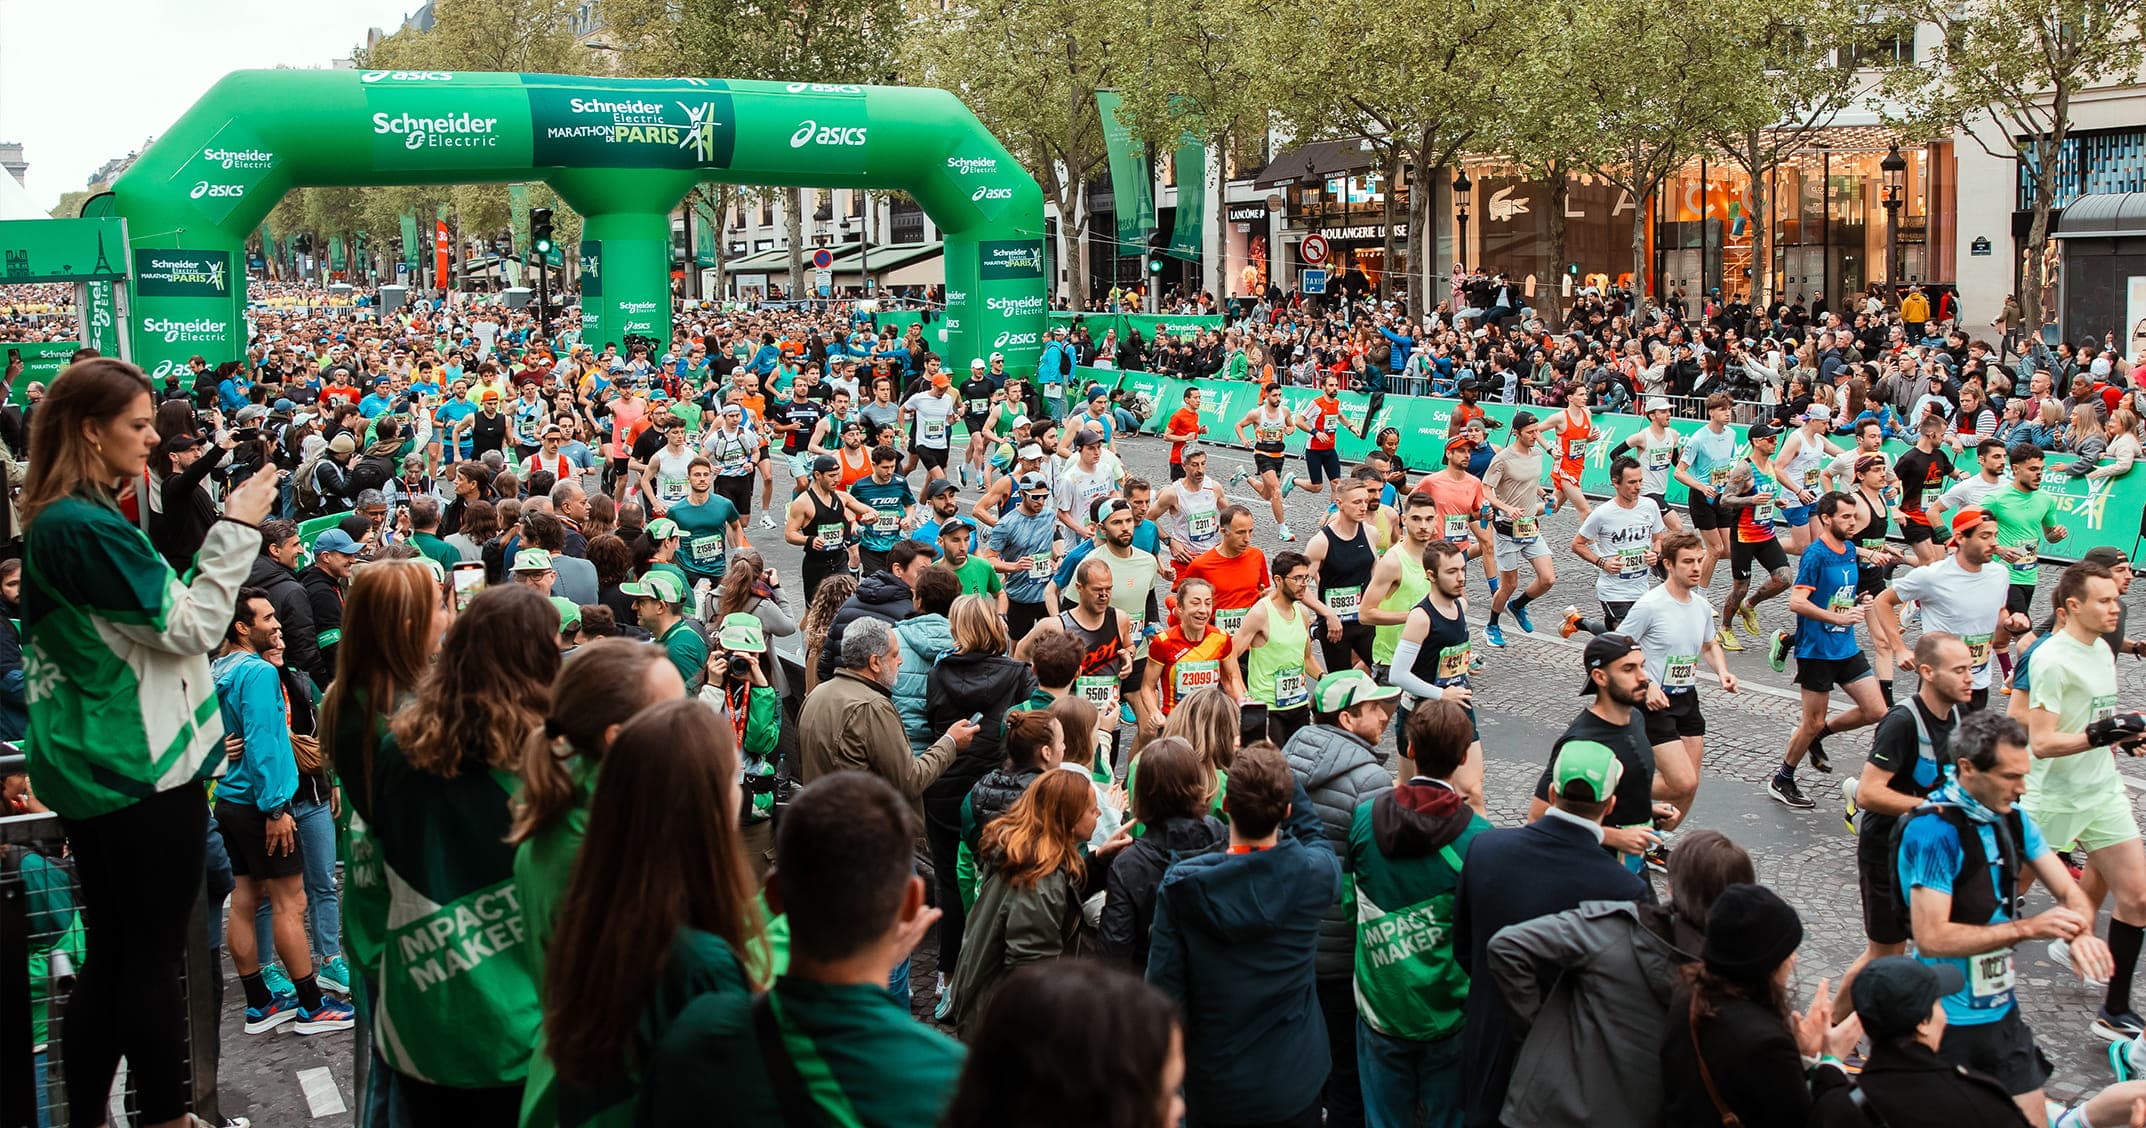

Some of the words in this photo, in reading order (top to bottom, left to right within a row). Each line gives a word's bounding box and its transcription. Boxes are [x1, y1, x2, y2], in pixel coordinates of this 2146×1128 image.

[569, 98, 663, 114] Schneider
[372, 112, 497, 134] Schneider
[613, 113, 664, 124] Electric
[428, 134, 497, 147] Electric
[547, 125, 615, 139] MARATHON
[605, 135, 615, 143] DE
[615, 126, 679, 145] PARIS
[815, 126, 867, 146] asics
[204, 148, 273, 161] Schneider
[234, 160, 273, 169] Electric
[947, 157, 997, 169] Schneider
[208, 184, 244, 197] asics
[985, 187, 1012, 199] asics
[1320, 226, 1376, 240] BOULANGERIE
[1377, 224, 1408, 238] LOISE
[993, 249, 1027, 257] Schneider
[151, 260, 199, 270] Schneider
[173, 275, 206, 283] PARIS
[619, 301, 656, 310] Schneider
[986, 296, 1043, 310] Schneider
[143, 318, 227, 333] Schneider
[179, 332, 226, 342] Electric
[1009, 333, 1037, 345] asics
[39, 350, 74, 359] Schneid
[1194, 519, 1209, 530] 2311
[696, 543, 716, 554] 21584
[1625, 555, 1643, 567] 2624
[1330, 596, 1355, 609] 69833
[1223, 617, 1241, 630] 1448
[1181, 672, 1211, 686] 23099
[1281, 677, 1299, 691] 3732
[1370, 926, 1444, 969] MAKER
